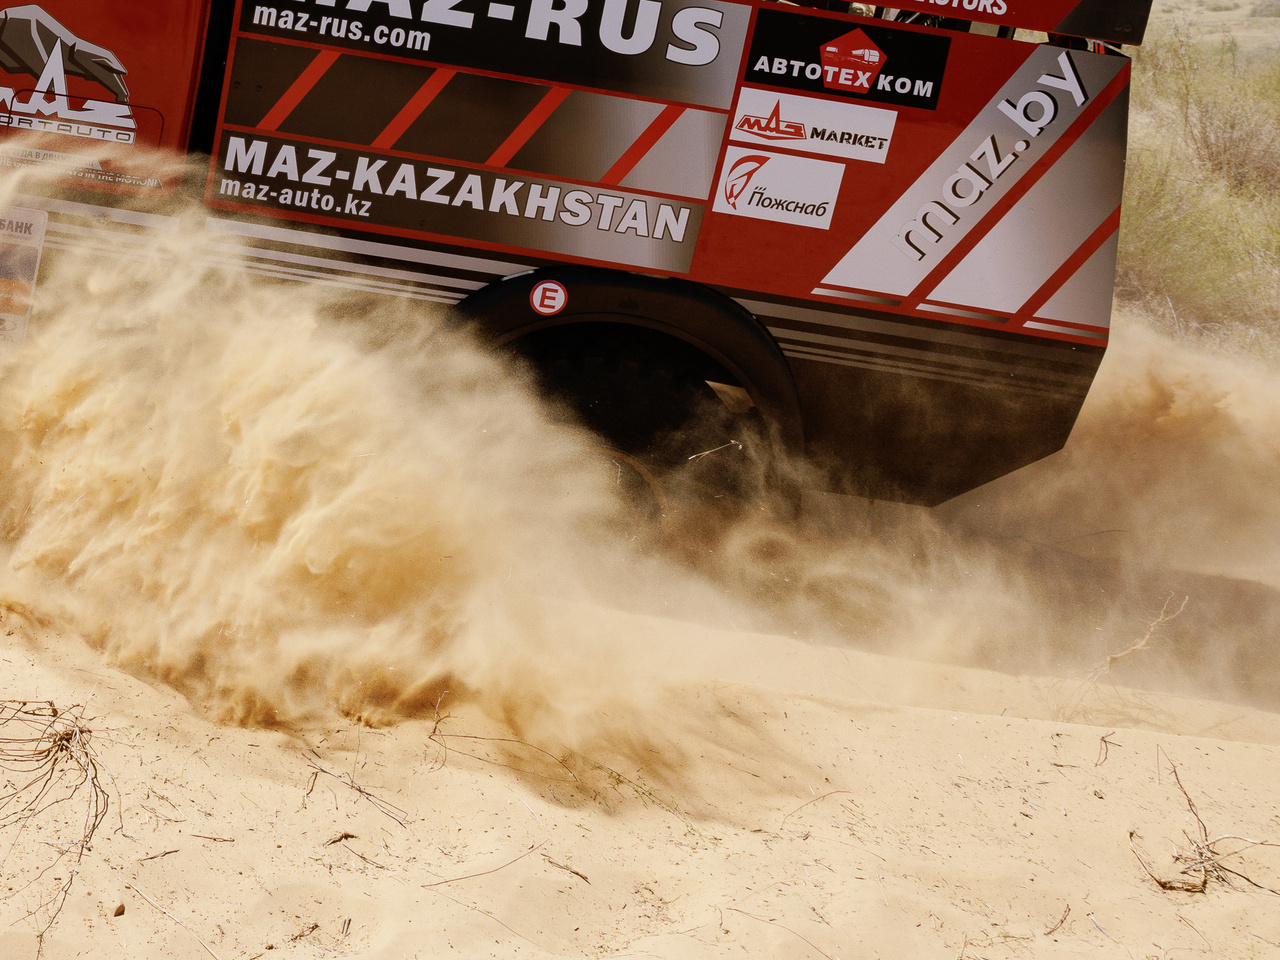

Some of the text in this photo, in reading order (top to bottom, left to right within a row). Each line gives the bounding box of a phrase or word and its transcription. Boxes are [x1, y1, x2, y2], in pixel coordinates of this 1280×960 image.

[252, 4, 432, 52] maz-rus.com
[810, 126, 888, 150] MARKET
[889, 50, 1090, 262] maz.by
[219, 178, 372, 218] maz-auto.kz
[224, 136, 692, 243] MAZ-KAZAKHSTAN
[538, 286, 558, 310] E
